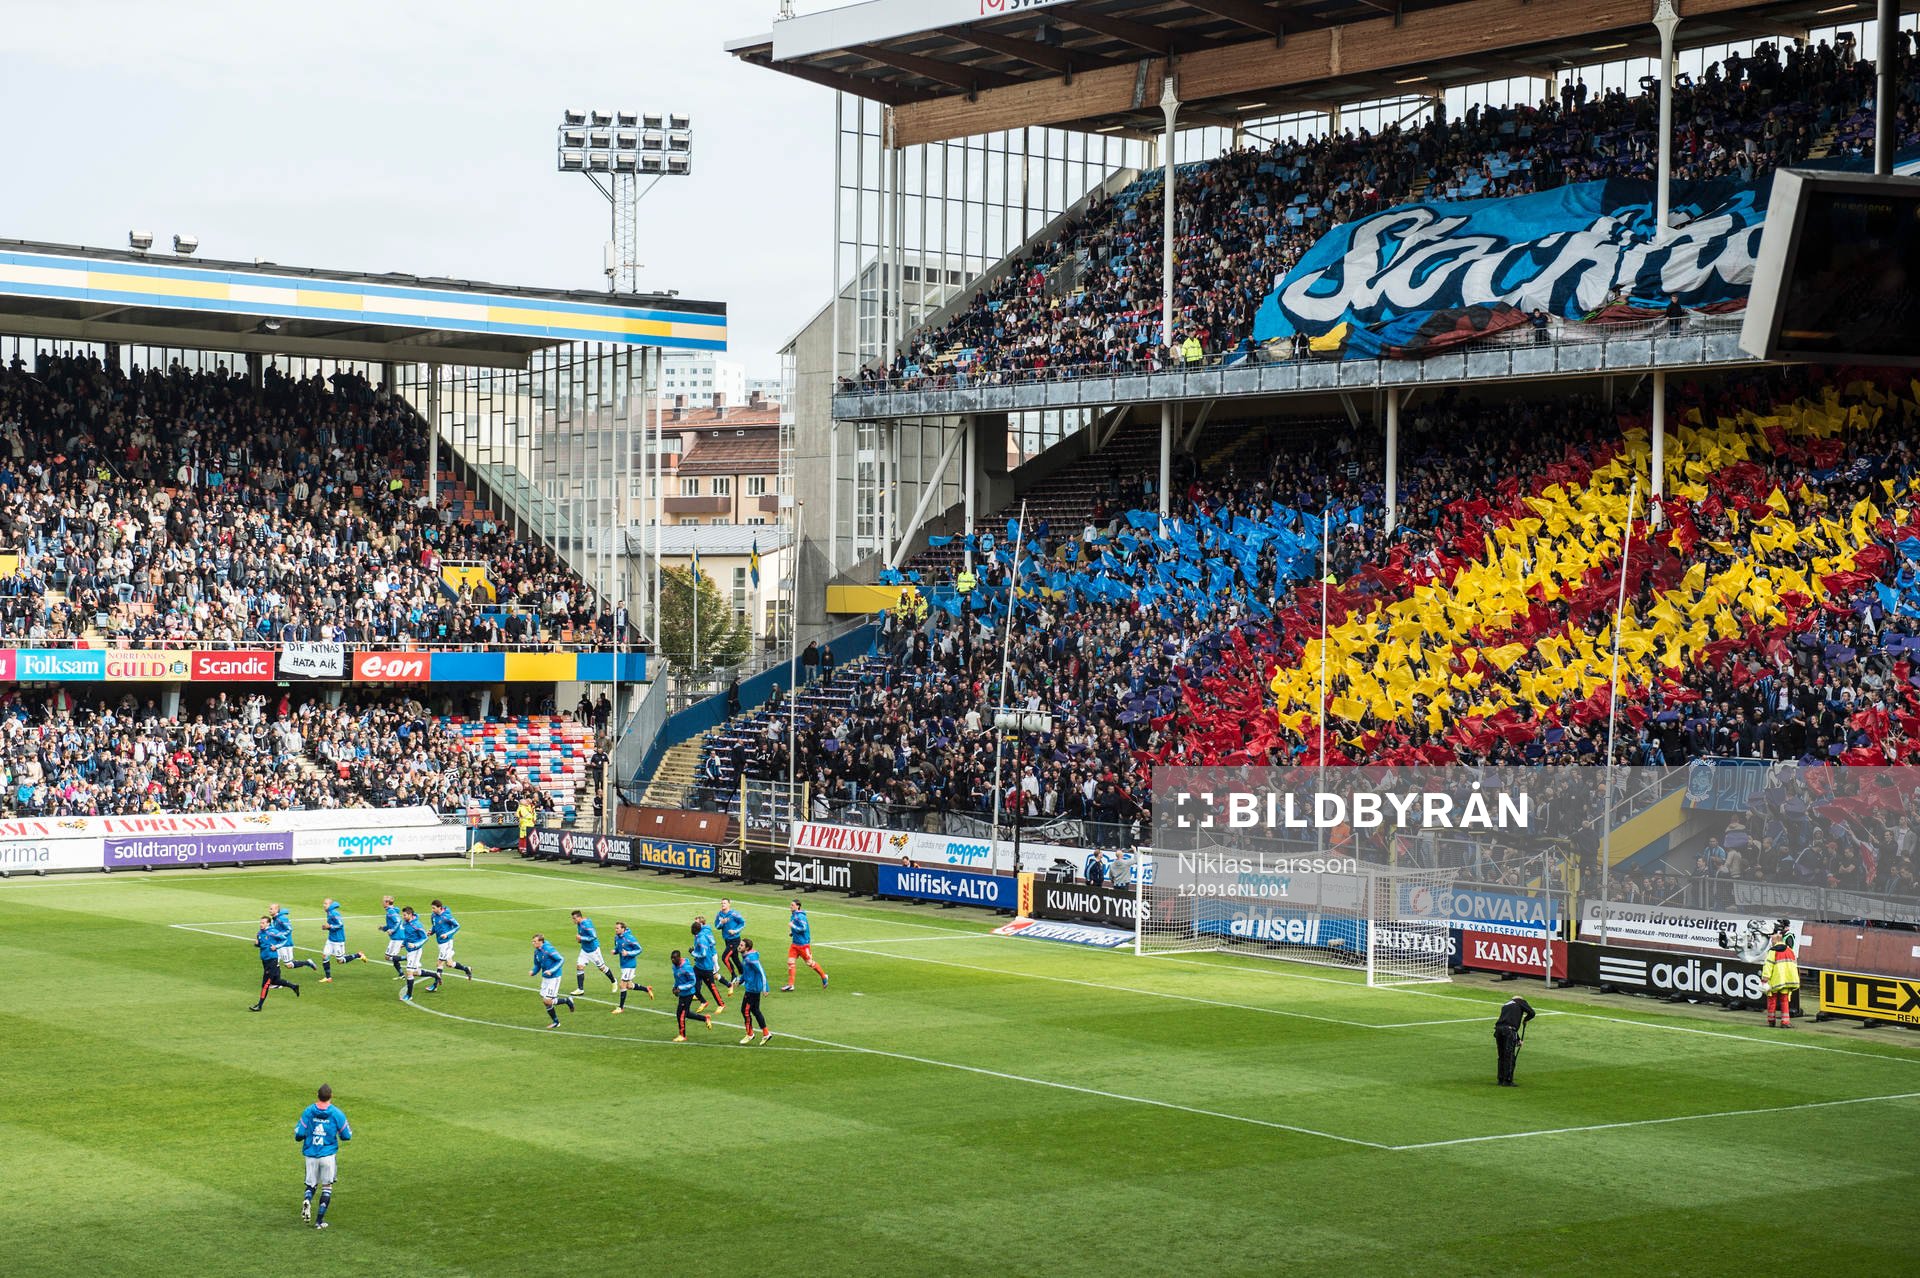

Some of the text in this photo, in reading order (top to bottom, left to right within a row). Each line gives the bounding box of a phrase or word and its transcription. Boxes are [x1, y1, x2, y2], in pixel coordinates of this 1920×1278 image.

[23, 655, 99, 675] Folksam
[107, 661, 166, 678] GULD
[199, 657, 268, 676] Scandic
[292, 657, 316, 668] HATA
[103, 817, 237, 833] EXPRESSEN
[338, 835, 393, 855] mopper
[539, 832, 560, 846] ROCK
[572, 836, 594, 850] ROCK
[608, 839, 630, 854] ROCK
[797, 824, 886, 854] EXPRESSEN
[114, 840, 284, 862] solidtango tv on your terms
[642, 844, 685, 866] Nacka
[687, 848, 711, 869] Trä
[723, 851, 740, 866] XL
[946, 842, 990, 865] mopper
[774, 856, 851, 888] stadium
[897, 872, 999, 901] Nilfisk-ALTO
[1046, 889, 1101, 914] KUMHO
[1437, 892, 1547, 927] CORVARA
[1230, 905, 1321, 944] ahlsell
[1618, 909, 1647, 923] som
[1650, 911, 1738, 932] idrottseliten
[1625, 928, 1656, 937] MINERALER
[1658, 931, 1688, 940] PROTEINER
[1475, 940, 1553, 968] KANSAS
[1651, 959, 1763, 1000] adidas
